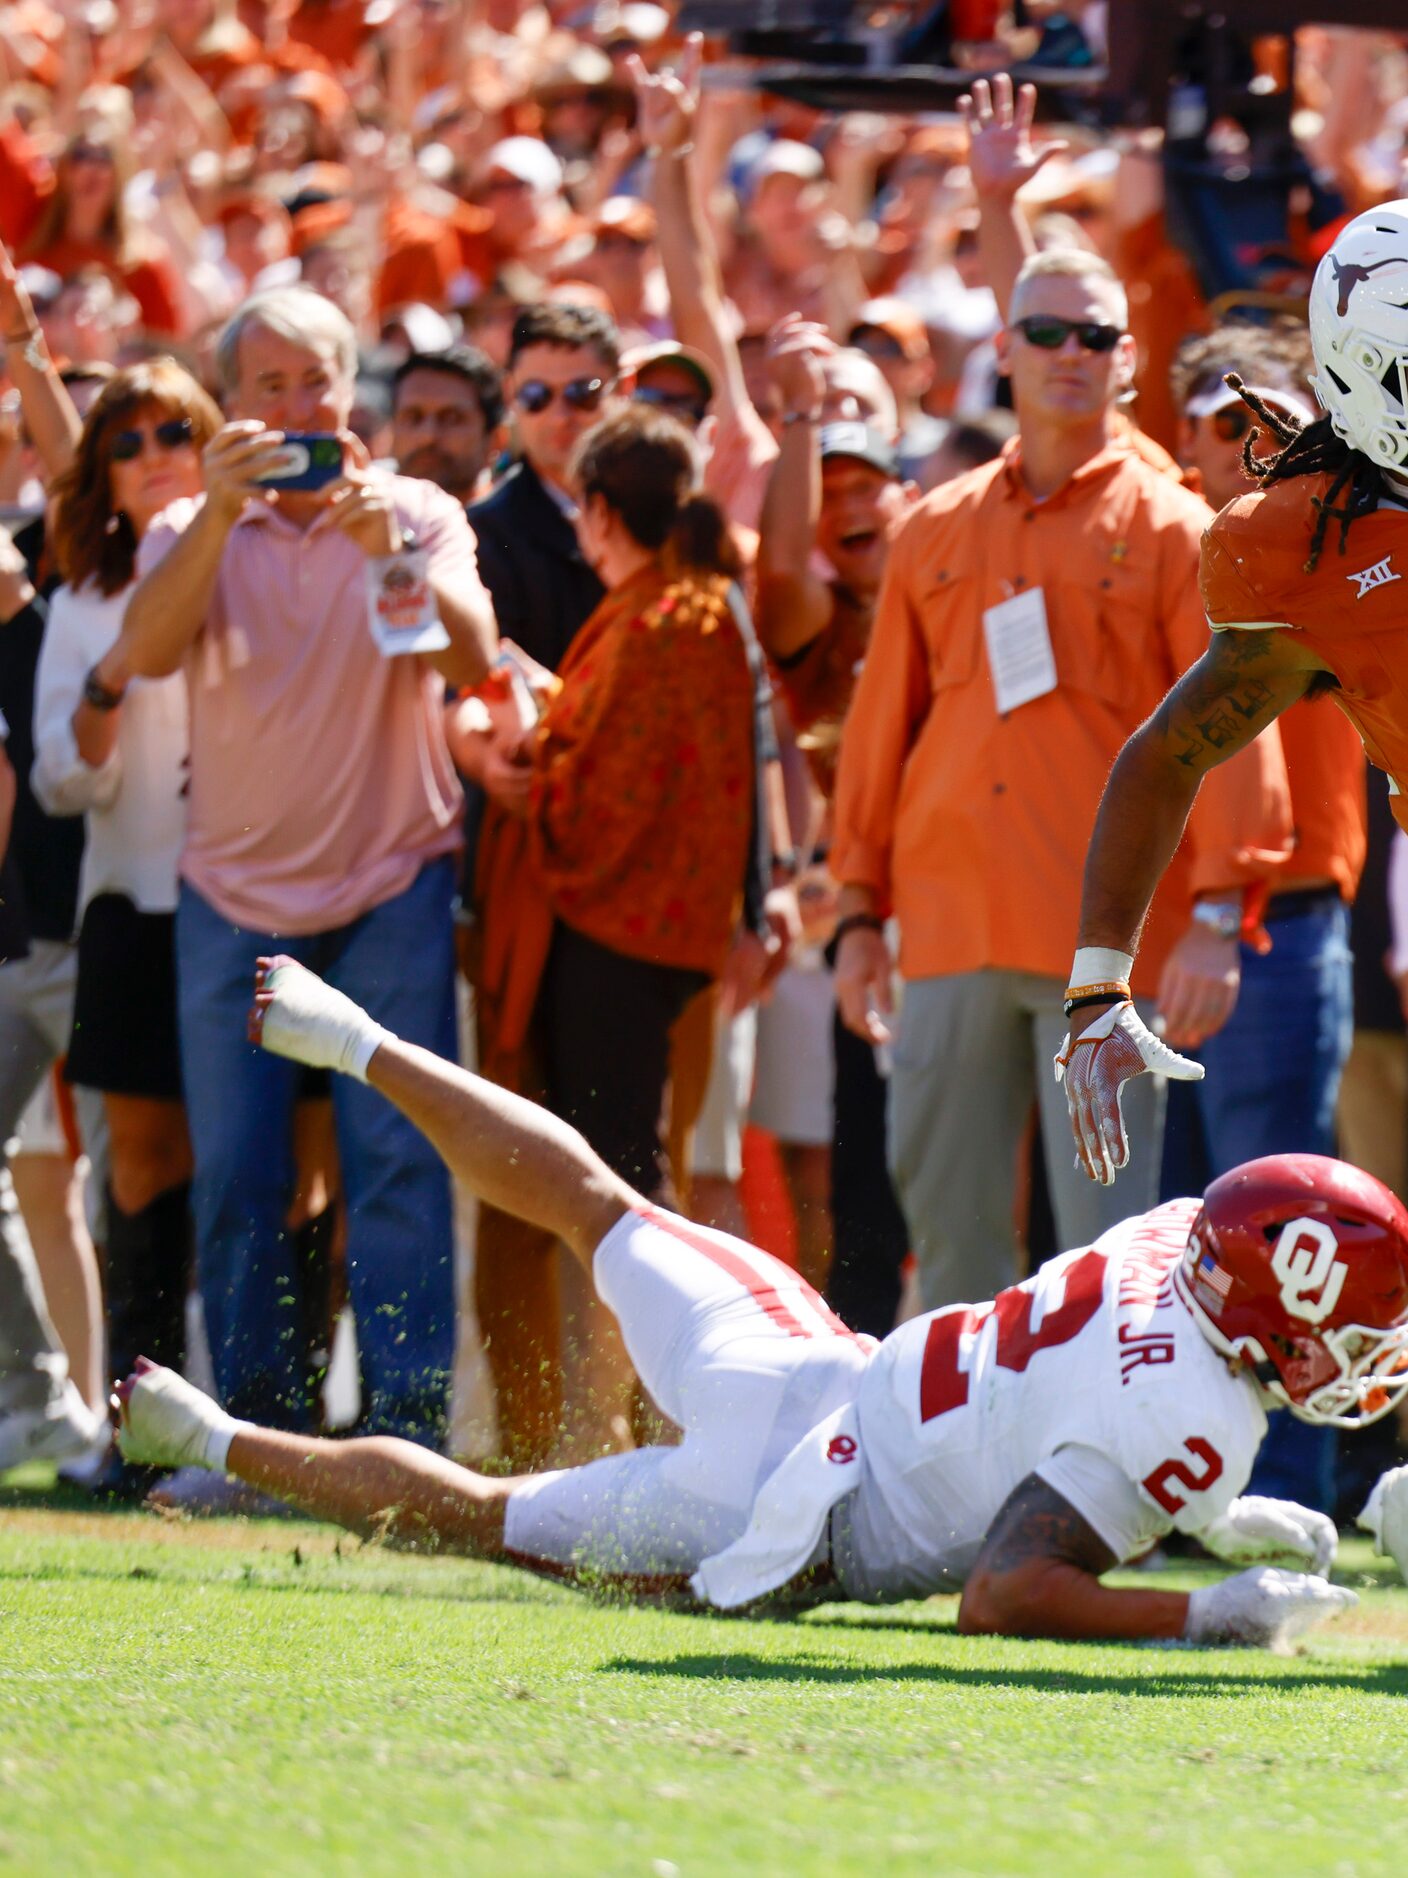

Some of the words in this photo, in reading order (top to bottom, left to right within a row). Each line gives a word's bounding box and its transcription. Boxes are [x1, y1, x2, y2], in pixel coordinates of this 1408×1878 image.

[1346, 555, 1402, 600] XII
[1271, 1216, 1349, 1325] OU
[920, 1249, 1110, 1425] 2
[1117, 1322, 1176, 1386] JR.
[1142, 1435, 1224, 1516] 2
